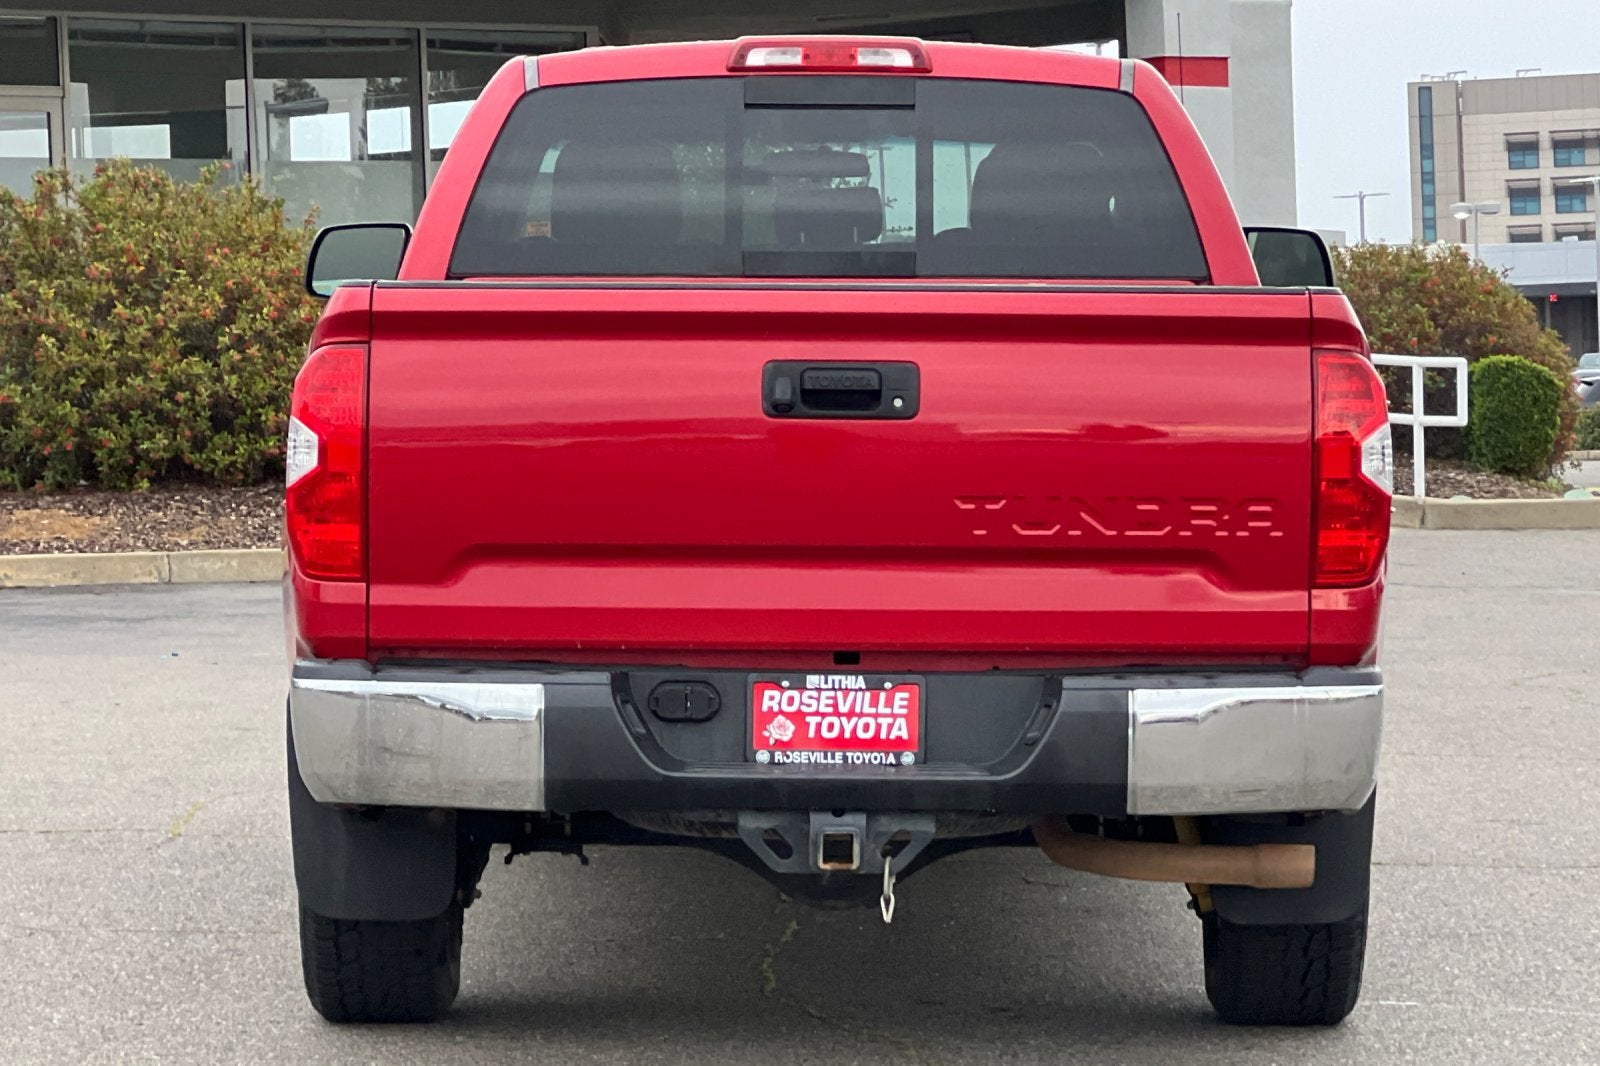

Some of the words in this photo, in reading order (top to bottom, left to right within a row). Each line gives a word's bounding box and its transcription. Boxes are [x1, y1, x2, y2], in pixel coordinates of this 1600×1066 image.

[807, 375, 875, 388] TOYOTA
[953, 496, 1284, 536] TUNDRA
[820, 675, 866, 689] LITHIA
[761, 690, 910, 713] ROSEVILLE
[805, 716, 909, 740] TOYOTA
[774, 751, 843, 764] ROSEVILLE
[846, 752, 896, 765] TOYOTA
